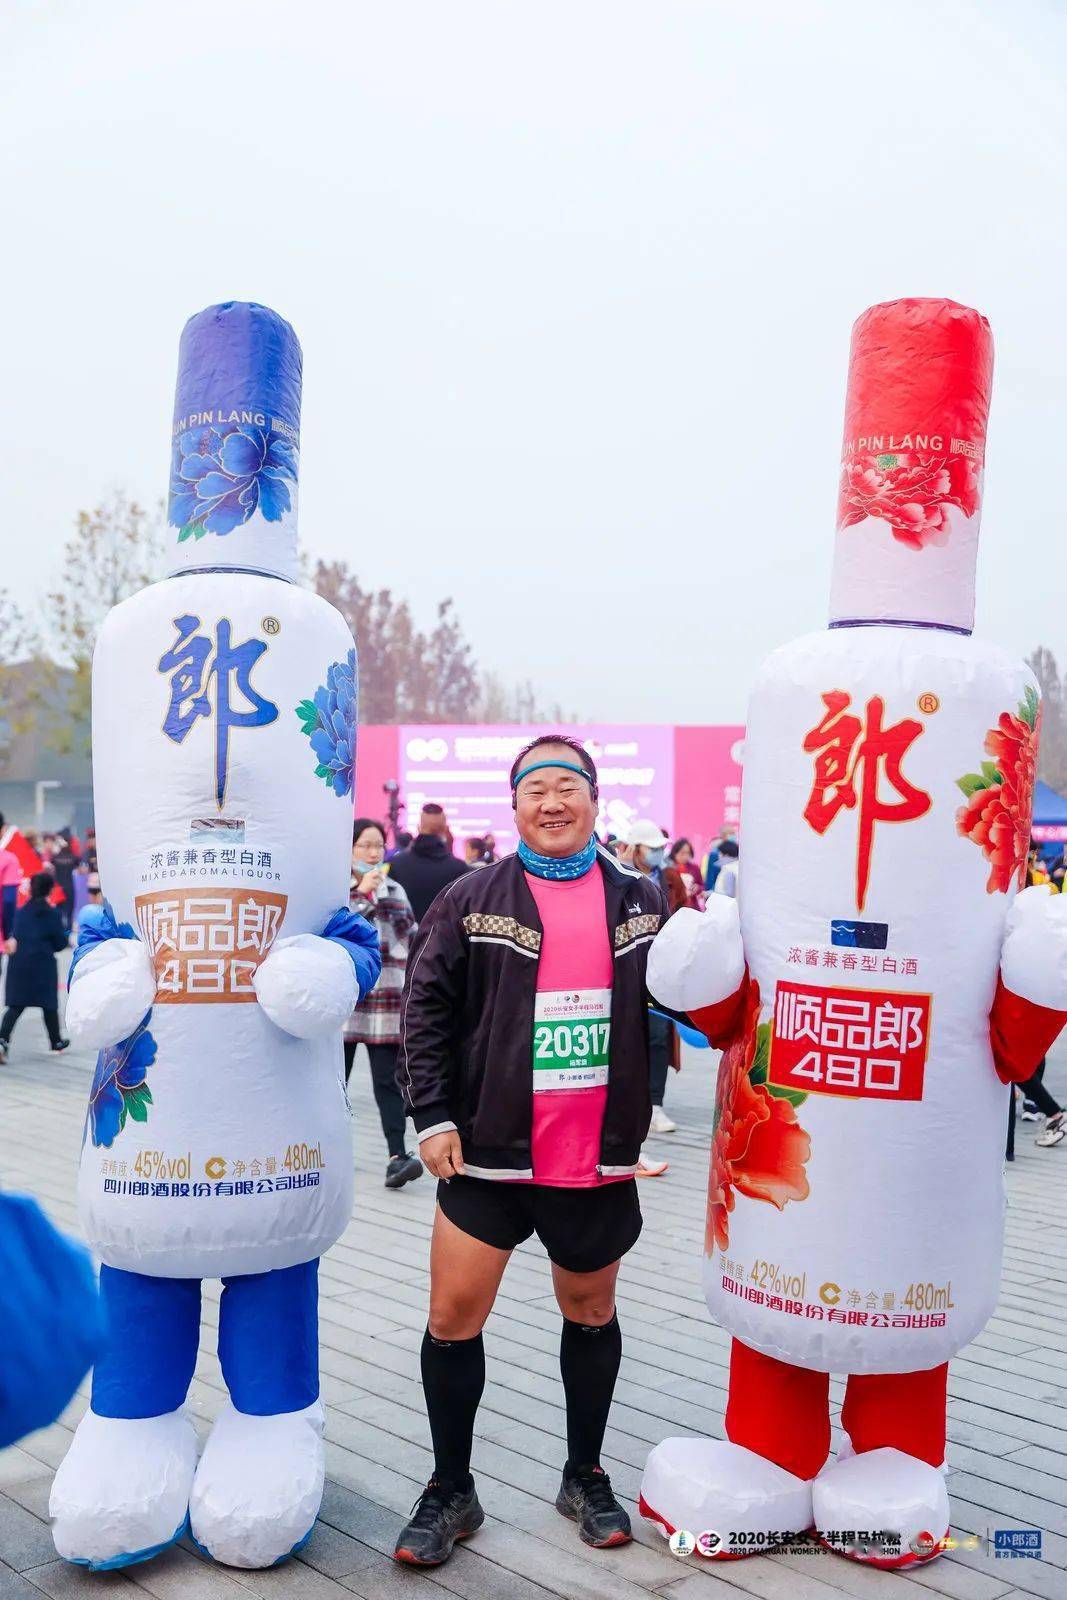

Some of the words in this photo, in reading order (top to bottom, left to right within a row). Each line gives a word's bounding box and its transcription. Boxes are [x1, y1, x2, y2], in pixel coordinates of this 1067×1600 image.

[189, 411, 213, 427] PIN
[218, 410, 265, 426] LANG
[858, 436, 883, 453] PIN
[888, 434, 942, 451] LANG
[157, 613, 280, 812] 郎
[802, 688, 933, 915] 郎
[150, 848, 273, 869] 浓酱兼香型白酒
[137, 897, 283, 956] 顺品郎
[786, 946, 918, 976] 浓酱兼香型白酒
[535, 1023, 610, 1059] 20317
[775, 990, 923, 1055] 顺品郎
[790, 1050, 902, 1091] 480
[103, 1172, 320, 1197] 四川郎酒股份有限公司出品
[722, 1275, 946, 1329] 四川郎酒股份有限公司出品
